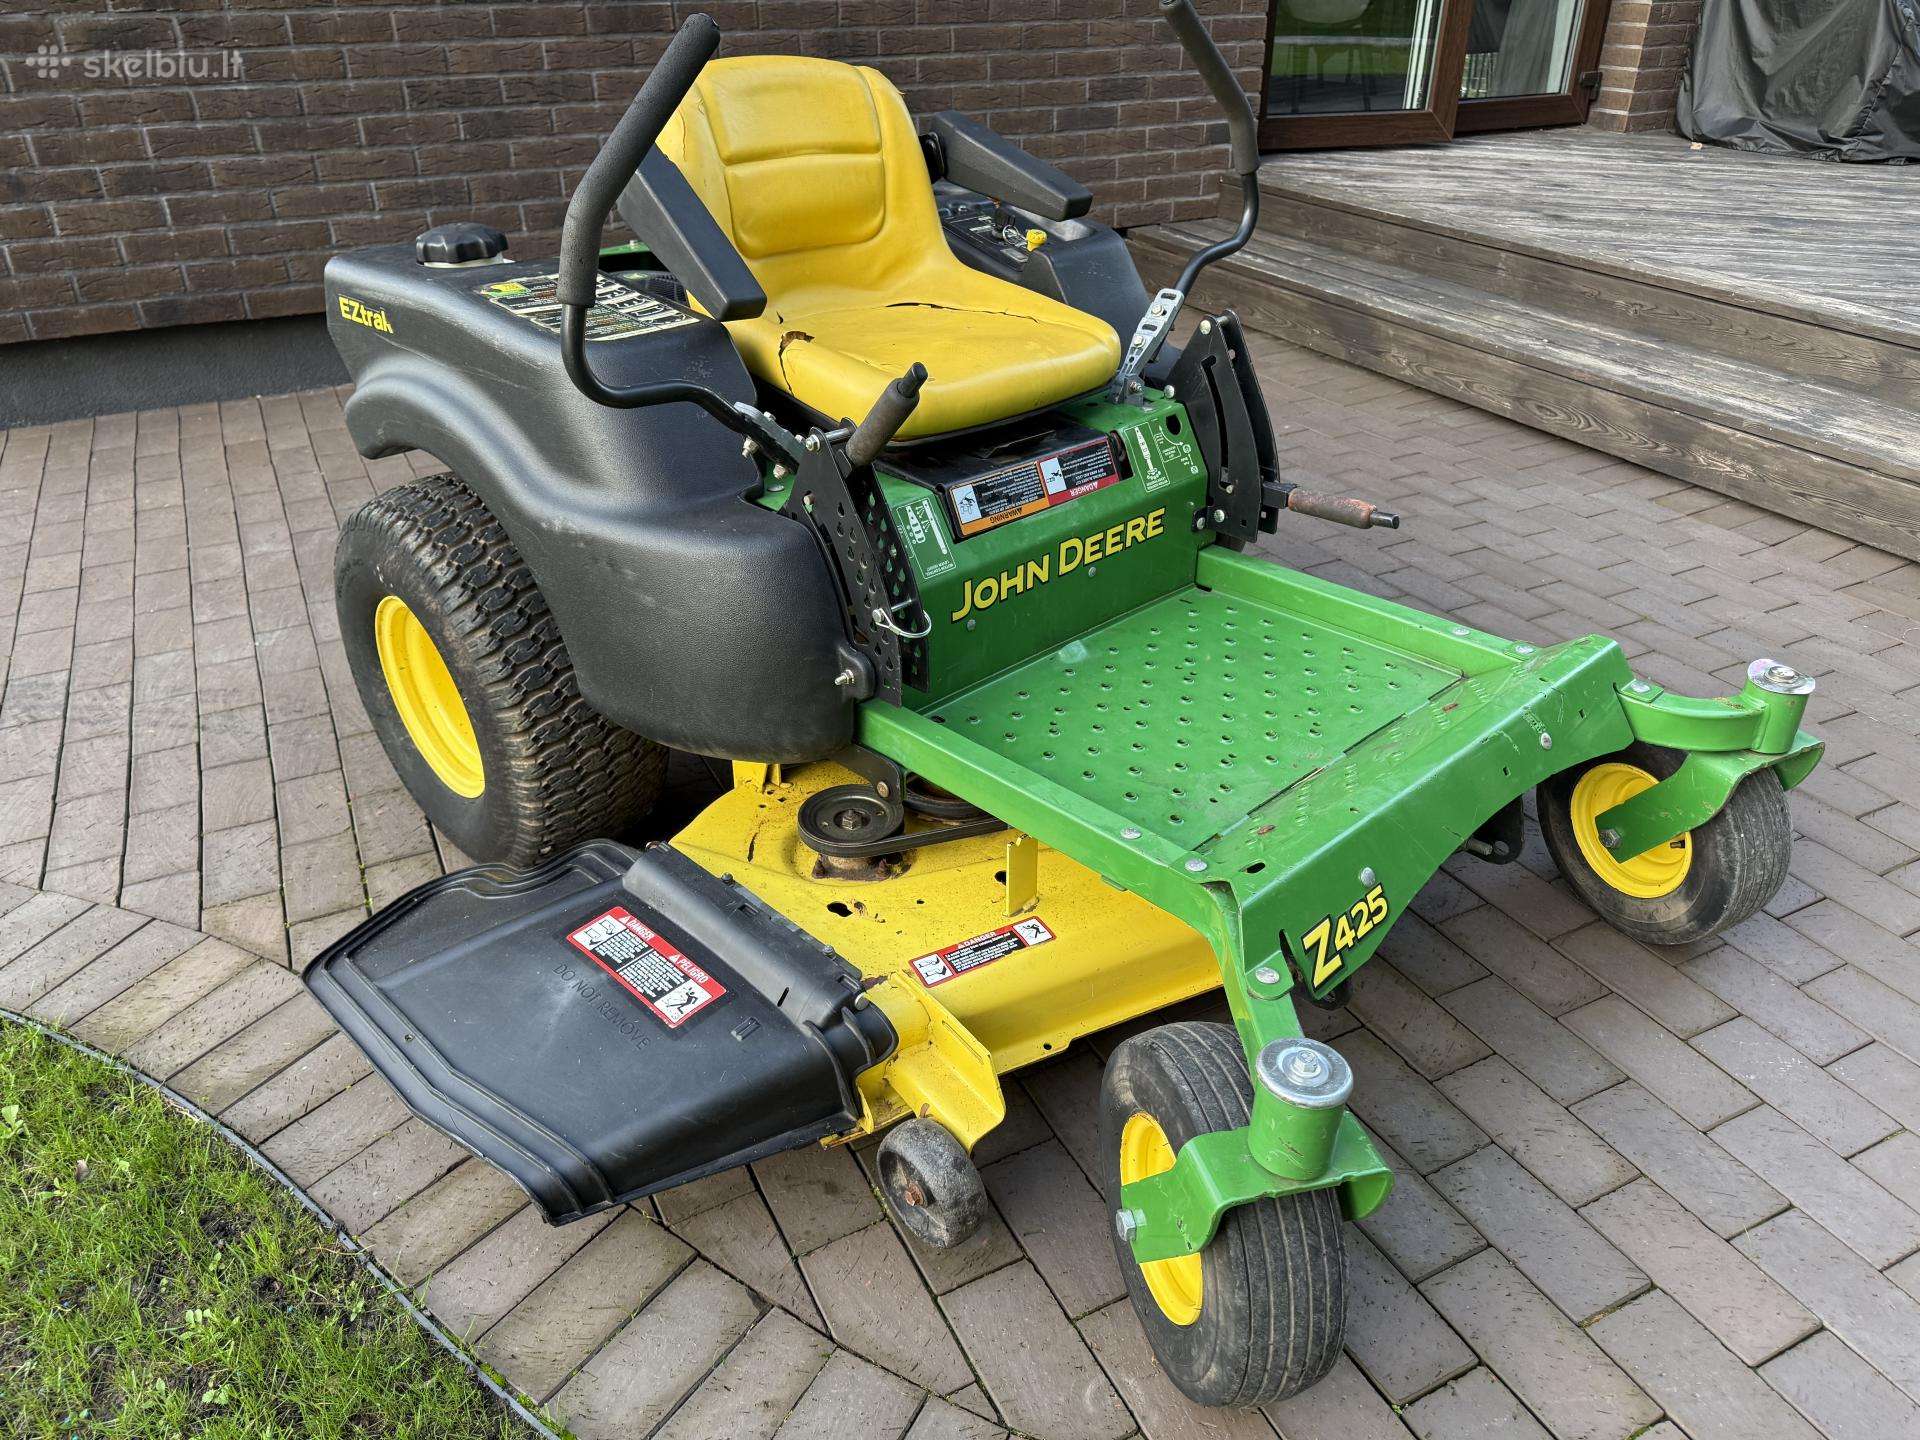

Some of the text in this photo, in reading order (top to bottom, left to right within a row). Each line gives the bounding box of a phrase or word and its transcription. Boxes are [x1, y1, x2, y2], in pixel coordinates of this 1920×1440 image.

[1069, 483, 1094, 498] DANGER
[989, 508, 1019, 524] WARNING
[952, 507, 1166, 622] JOHN DEERE
[626, 919, 655, 941] DANGER
[963, 931, 997, 947] DANGER
[1302, 884, 1388, 990] Z425
[676, 958, 709, 984] PELIGRO
[552, 963, 651, 1050] DO NOT REMOVE
